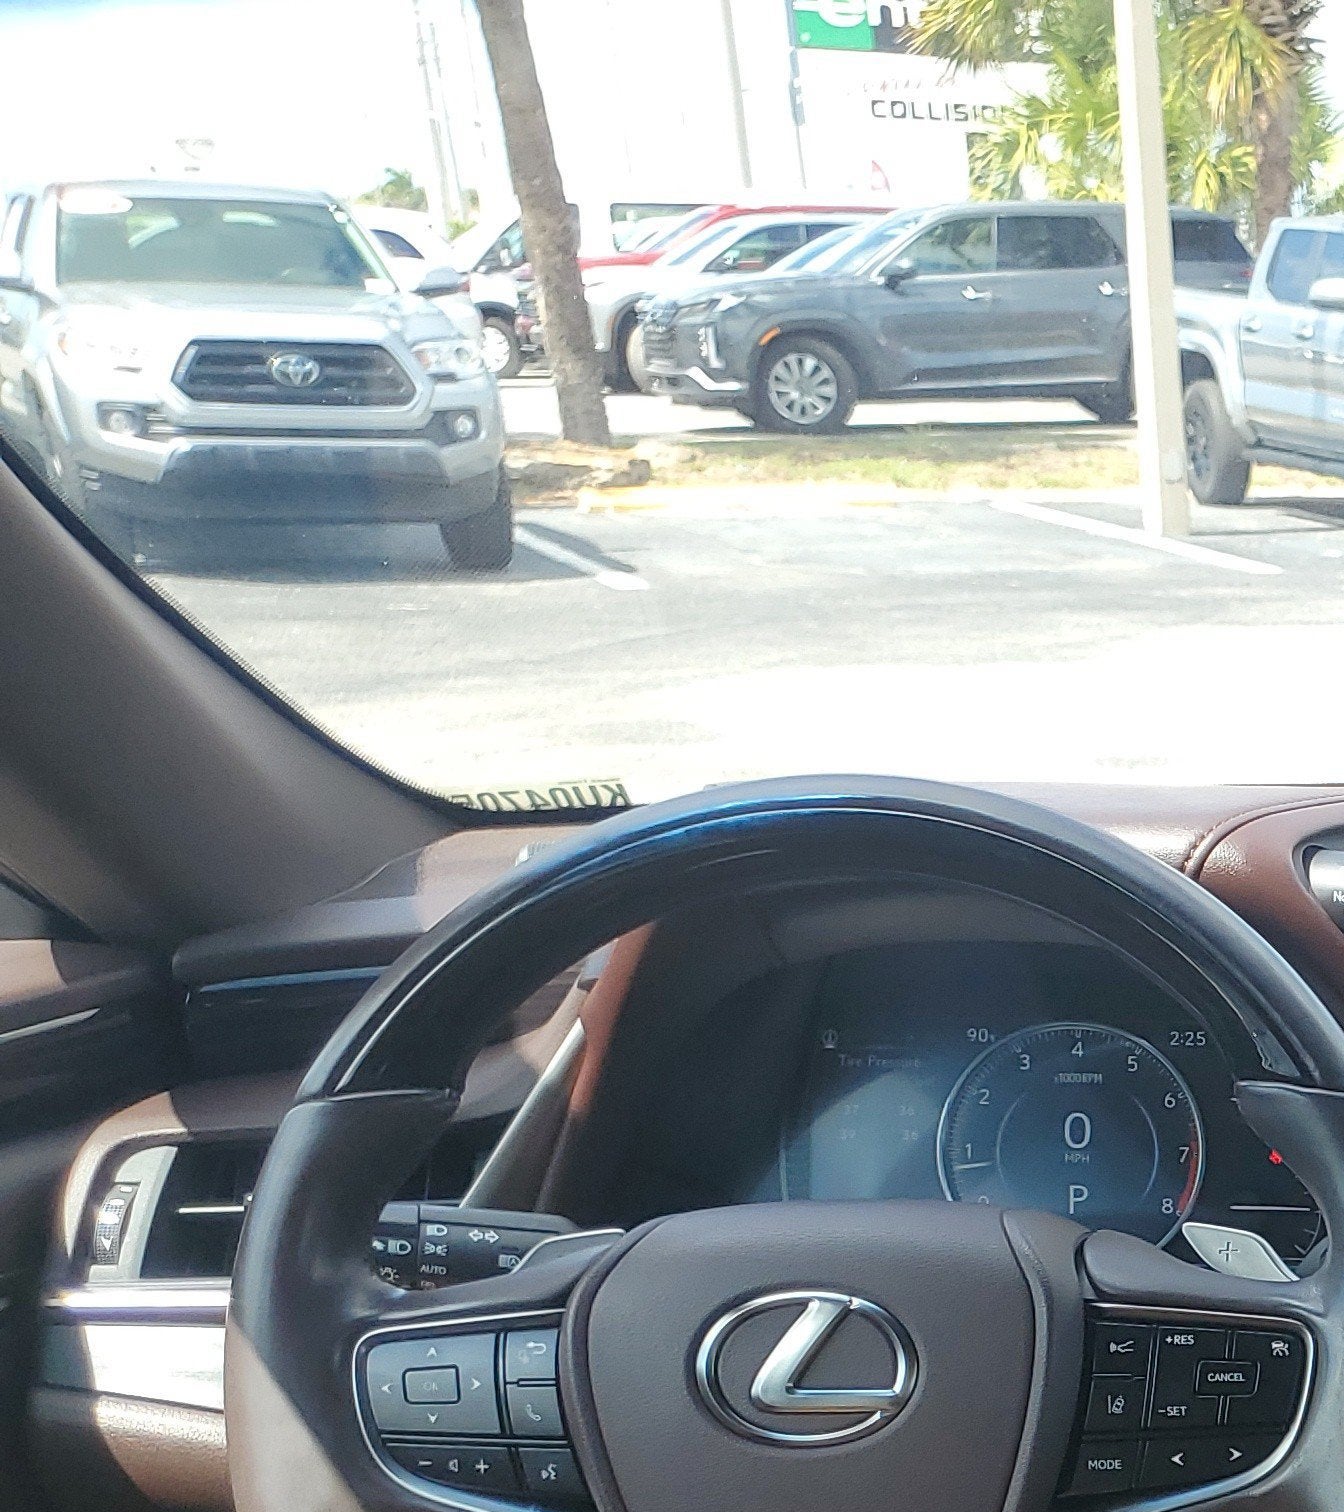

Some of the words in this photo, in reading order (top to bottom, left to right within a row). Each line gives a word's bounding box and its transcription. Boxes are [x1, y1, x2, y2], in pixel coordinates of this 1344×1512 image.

[871, 99, 1015, 122] COLLISIO
[1169, 1030, 1206, 1047] 2:25
[1071, 1041, 1084, 1058] 4
[1019, 1054, 1031, 1071] 3
[1127, 1056, 1139, 1072] 5
[979, 1089, 990, 1105] 2
[1164, 1092, 1176, 1109] 6
[1064, 1112, 1093, 1149] 0
[965, 1143, 973, 1160] 1
[1178, 1146, 1190, 1163] 7
[1068, 1185, 1089, 1215] P
[1161, 1198, 1174, 1215] 8
[420, 1264, 447, 1275] AUTO
[1207, 1372, 1246, 1383] CANCEL
[1088, 1459, 1123, 1471] MODE
